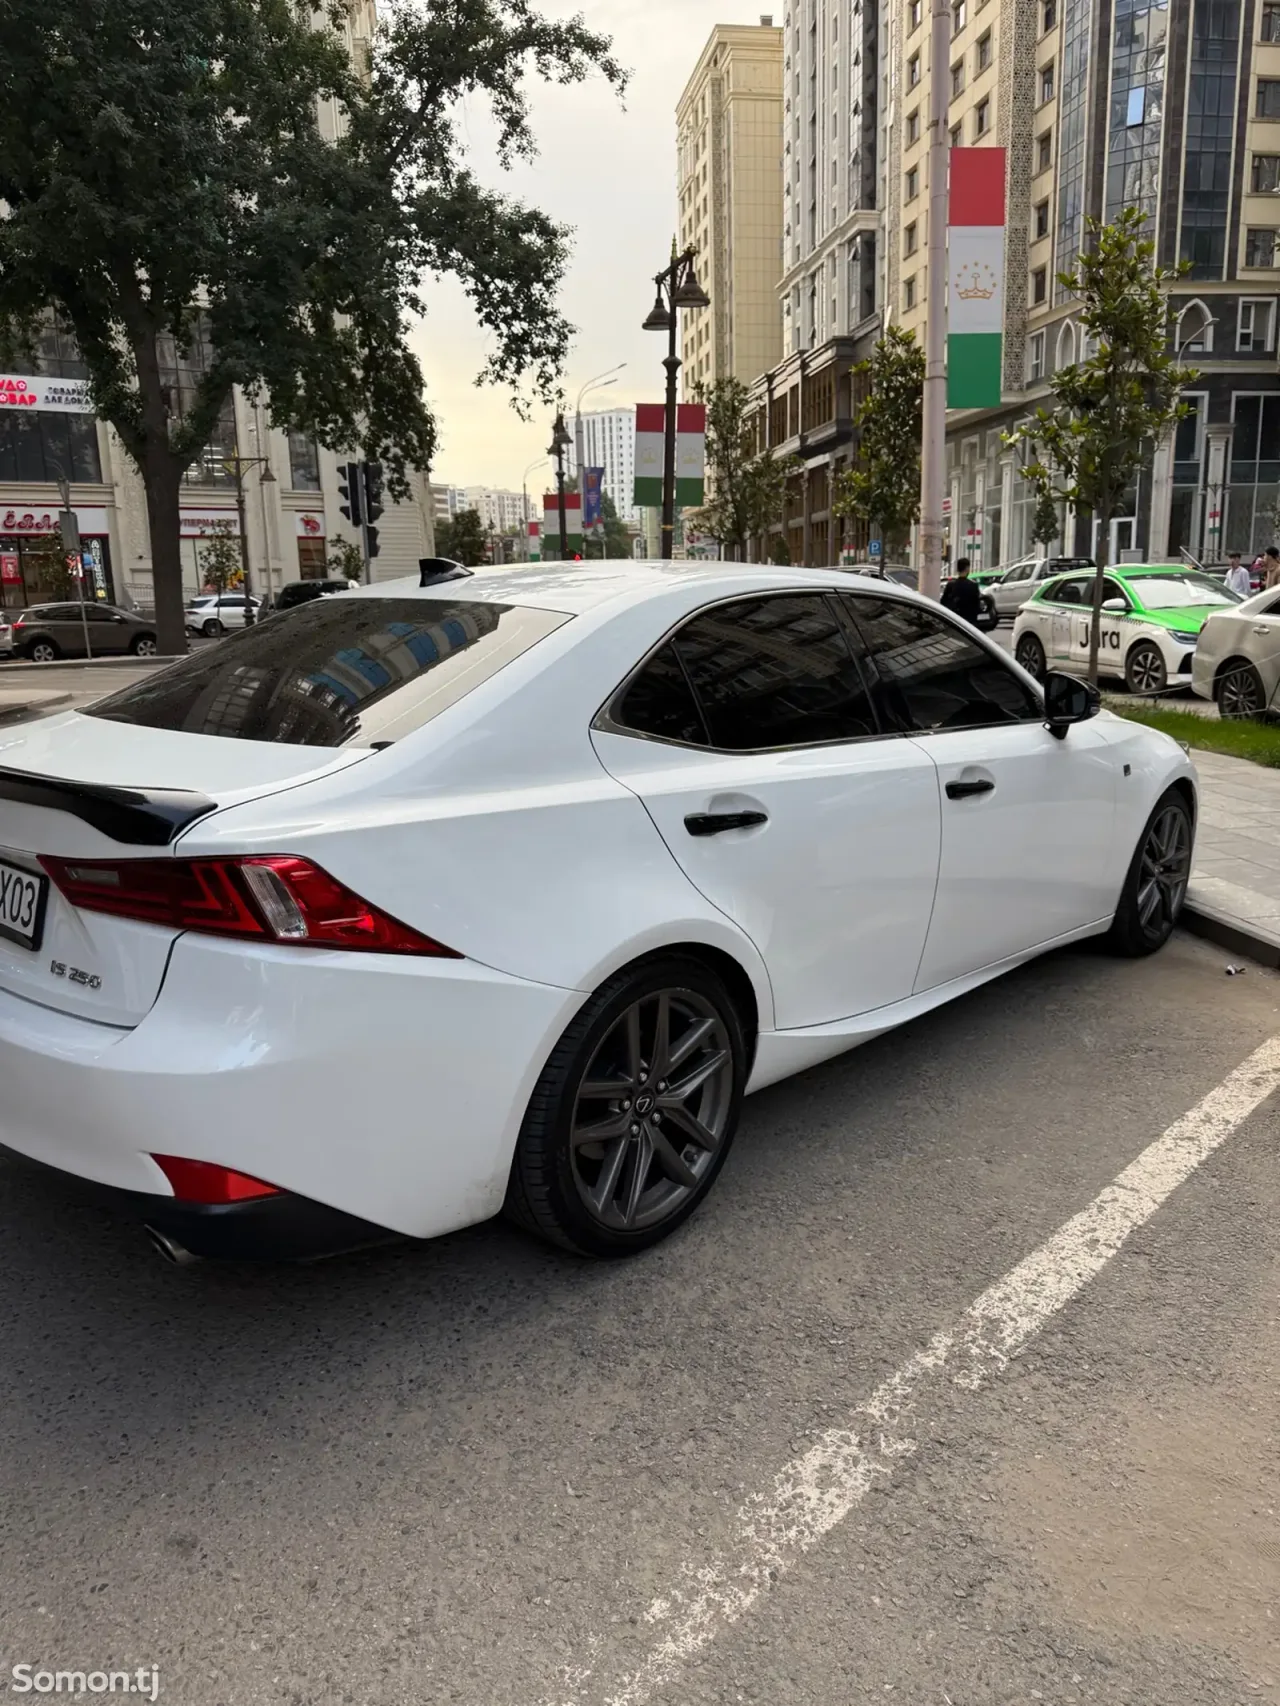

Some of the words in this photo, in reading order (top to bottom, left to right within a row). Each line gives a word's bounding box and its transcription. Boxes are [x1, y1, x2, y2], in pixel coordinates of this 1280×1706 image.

[1079, 621, 1121, 649] Jra
[50, 960, 67, 976] IS
[68, 966, 102, 989] 250
